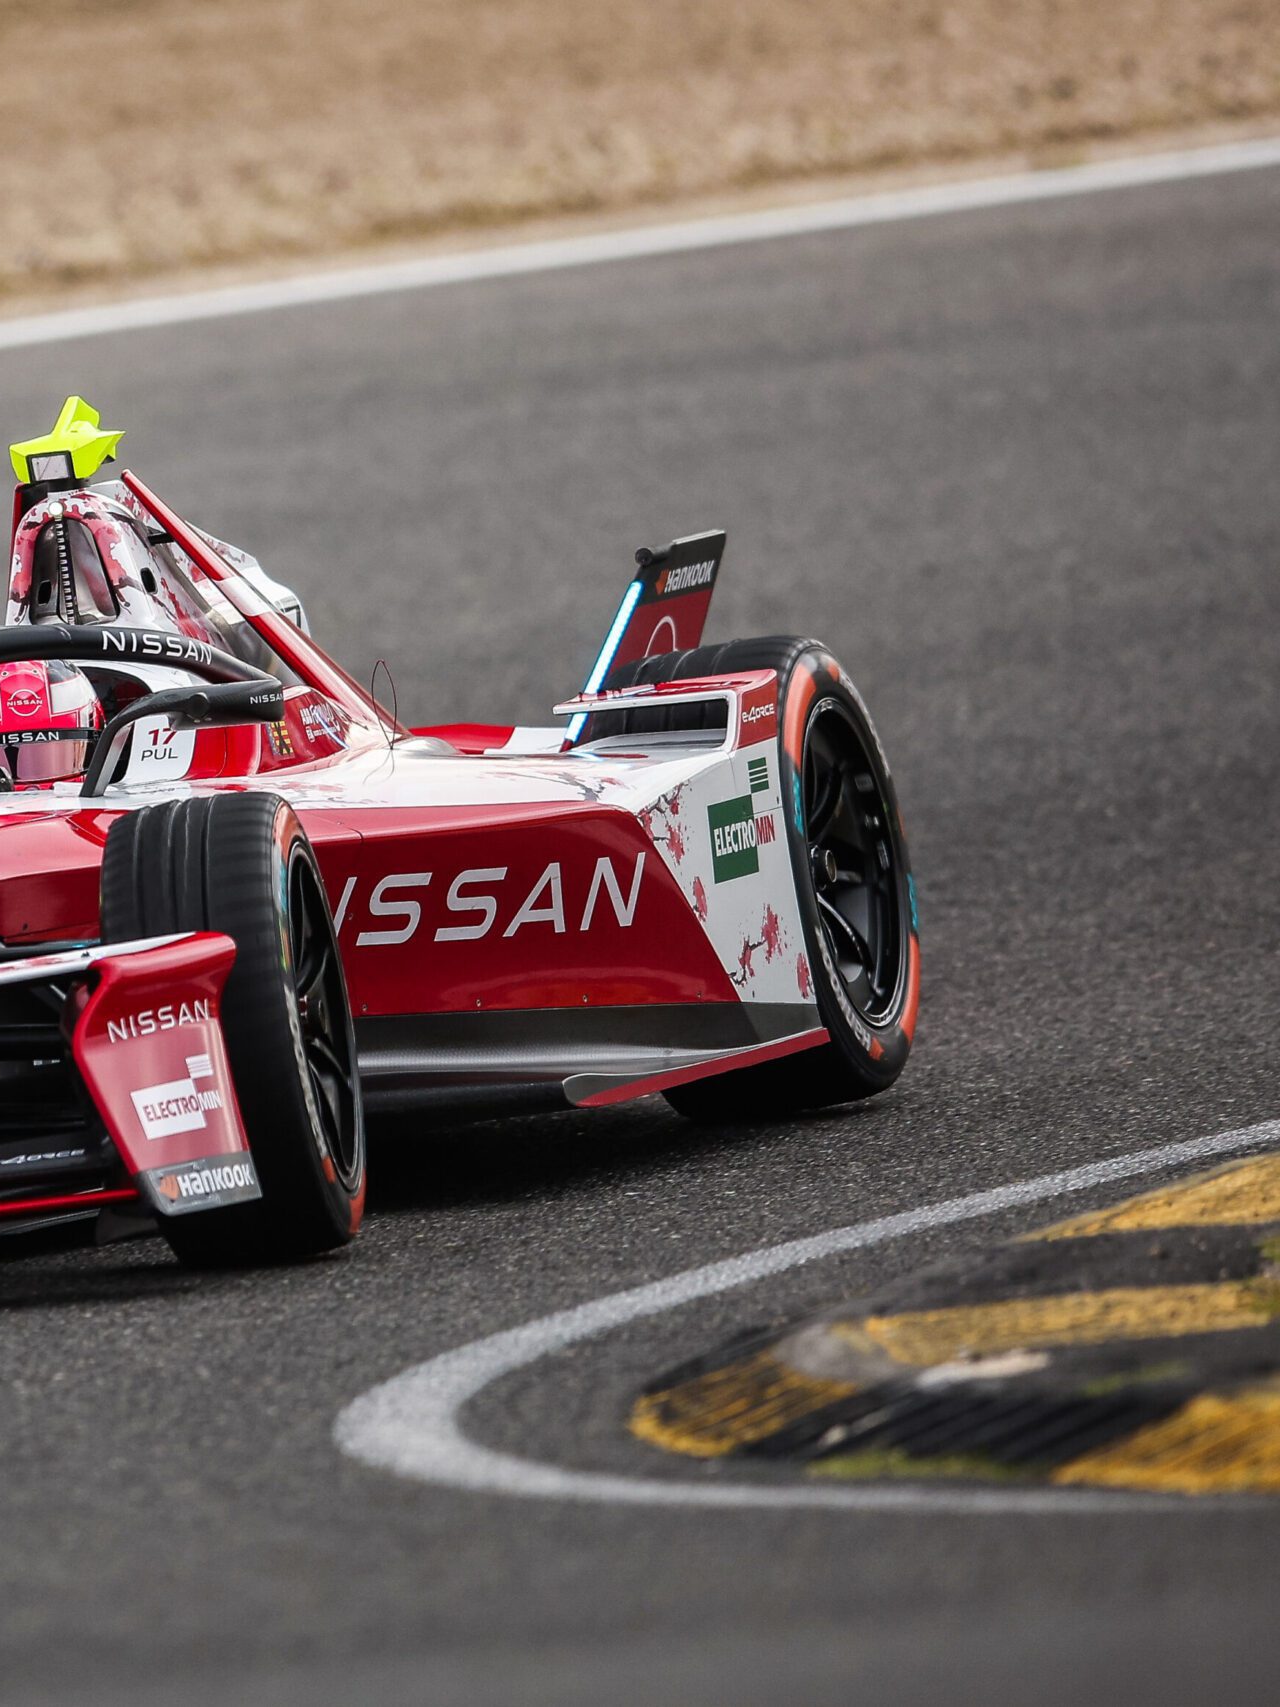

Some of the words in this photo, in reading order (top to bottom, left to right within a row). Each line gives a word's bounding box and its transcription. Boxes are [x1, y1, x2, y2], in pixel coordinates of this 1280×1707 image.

[102, 630, 213, 666] NISSAN
[6, 699, 43, 707] NISSAN
[141, 748, 179, 762] PUL
[148, 728, 178, 747] 17
[713, 813, 776, 858] ELECTROMIN
[332, 851, 646, 947] ISSAN
[107, 998, 211, 1044] NISSAN
[141, 1089, 224, 1124] ELECTROMIN
